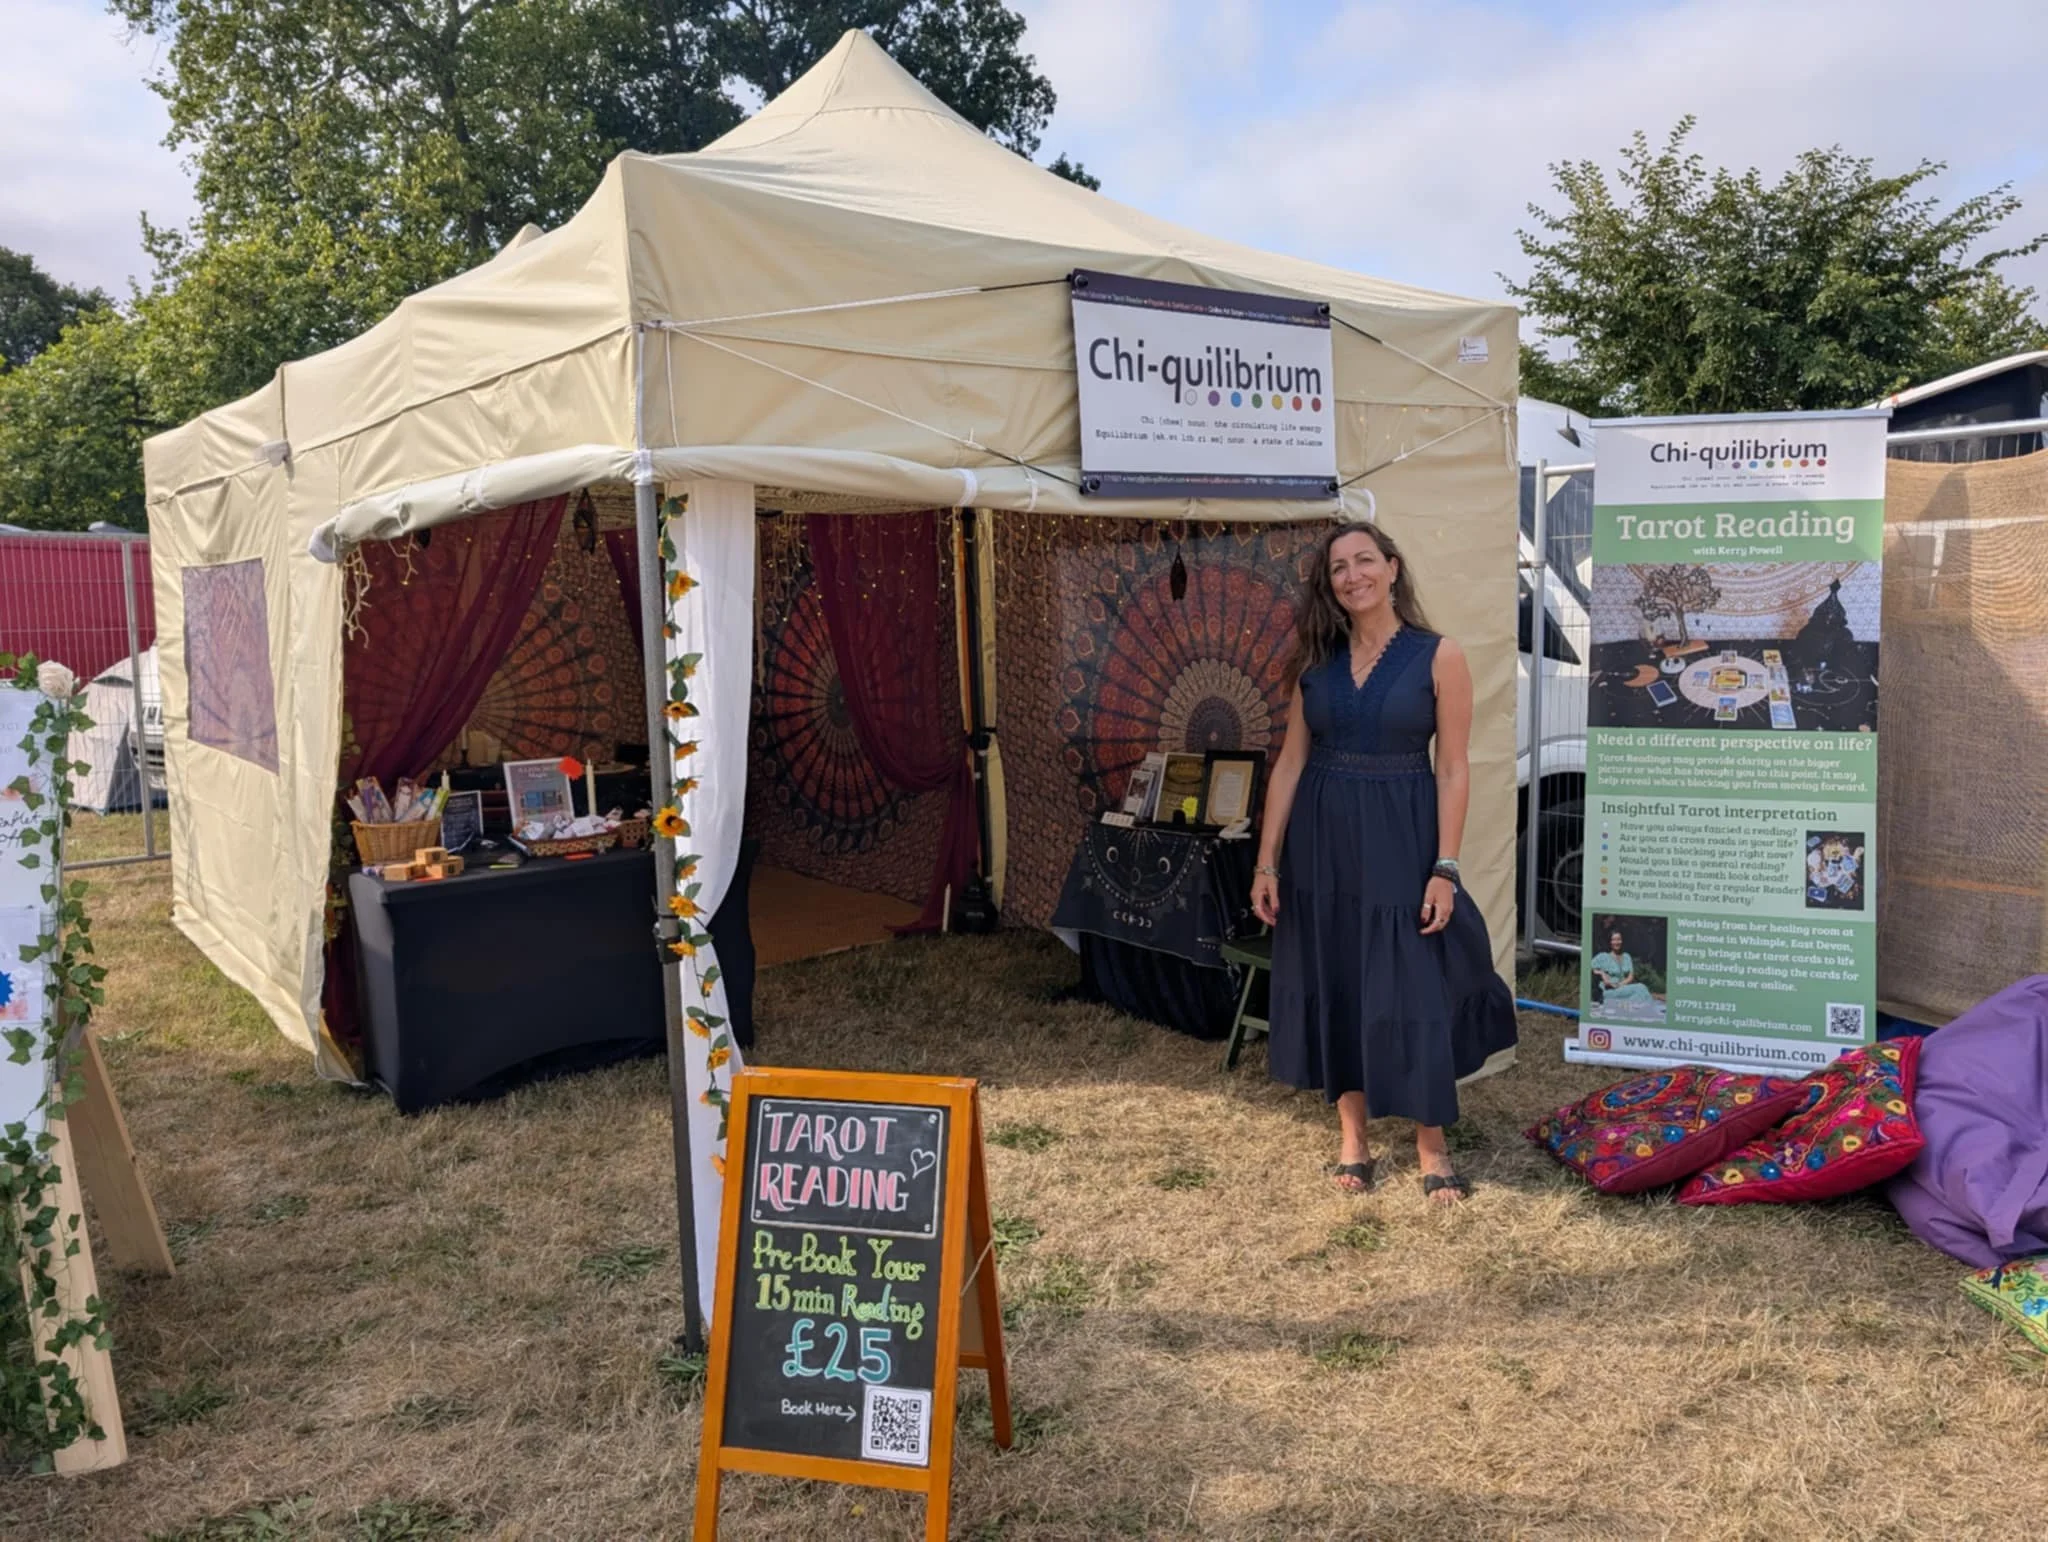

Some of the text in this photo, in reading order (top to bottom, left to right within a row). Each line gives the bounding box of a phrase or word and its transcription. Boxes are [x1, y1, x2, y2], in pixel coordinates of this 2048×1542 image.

[1089, 337, 1322, 403] Chi-quilibrium
[1095, 429, 1148, 440] Equilibrium
[1231, 421, 1278, 432] circulating
[1281, 422, 1296, 431] life
[1650, 439, 1827, 470] Chi-quilibrium
[1616, 510, 1855, 543] Tarot Reading
[1692, 545, 1783, 557] with Kerry Powell
[1597, 734, 1872, 752] Need a different perspective on life?
[1598, 753, 1624, 762] Tarot
[1627, 754, 1671, 765] Readings
[1673, 757, 1695, 766] may
[1696, 756, 1734, 766] provide
[1736, 756, 1771, 767] clarity
[1788, 758, 1805, 767] the
[1807, 758, 1840, 769] bigger
[1598, 765, 1632, 775] picture
[1647, 766, 1672, 775] what
[1674, 766, 1692, 776] has
[1694, 767, 1734, 778] brought
[1736, 769, 1754, 778] you
[1757, 769, 1768, 777] to
[1769, 769, 1789, 778] this
[1823, 771, 1831, 779] It
[1832, 772, 1857, 782] may
[1598, 776, 1619, 786] help
[1620, 777, 1651, 785] reveal
[1687, 778, 1730, 789] blocking
[1732, 781, 1751, 790] you
[1753, 781, 1778, 789] from
[1780, 782, 1819, 793] moving
[1821, 782, 1868, 792] forward.
[1601, 801, 1838, 822] Insightful Tarot interpretation
[1620, 822, 1644, 831] Have
[1646, 824, 1664, 832] you
[1667, 823, 1702, 834] always
[1704, 825, 1741, 834] fancied
[1752, 827, 1797, 838] reading?
[1620, 833, 1637, 841] Are
[1659, 835, 1669, 843] at
[1708, 837, 1736, 845] roads
[1738, 838, 1748, 846] in
[1750, 839, 1774, 848] your
[1776, 839, 1798, 848] life?
[1619, 844, 1637, 853] Ask
[1674, 847, 1716, 858] blocking
[1718, 850, 1737, 858] you
[1739, 850, 1765, 859] right
[1767, 850, 1794, 859] now?
[1619, 855, 1785, 873] Would you like a general reading?
[1619, 867, 1640, 876] How
[1643, 868, 1670, 877] about
[1682, 870, 1692, 878] 12
[1694, 871, 1726, 880] month
[1729, 872, 1749, 880] look
[1751, 873, 1789, 883] ahead?
[1619, 878, 1804, 895] Are you looking for a regular Reader?
[1619, 889, 1640, 899] Why
[1643, 891, 1658, 899] not
[1660, 891, 1682, 901] hold
[1692, 893, 1720, 903] Tarot
[1677, 918, 1854, 937] Working from her healing room at
[1676, 932, 1693, 942] her
[1696, 933, 1725, 943] home
[1726, 935, 1738, 944] in
[1791, 939, 1814, 949] East
[1676, 947, 1855, 966] Kerry brings the tarot cards to life
[1676, 960, 1859, 981] by intuitively reading the cards for
[1676, 976, 1695, 986] you
[1697, 976, 1707, 984] in
[1709, 978, 1745, 988] person
[1760, 980, 1798, 992] online.
[1674, 1011, 1812, 1032] kerry@chi-quilibrium.com
[1623, 1034, 1826, 1064] www.chi-quilibrium.com
[764, 1112, 898, 1161] TAROT
[759, 1162, 910, 1212] READING
[753, 1229, 926, 1281] Pre-Book Your
[841, 1283, 925, 1340] Reading
[782, 1318, 892, 1386] £25
[781, 1398, 842, 1416] Book Here
